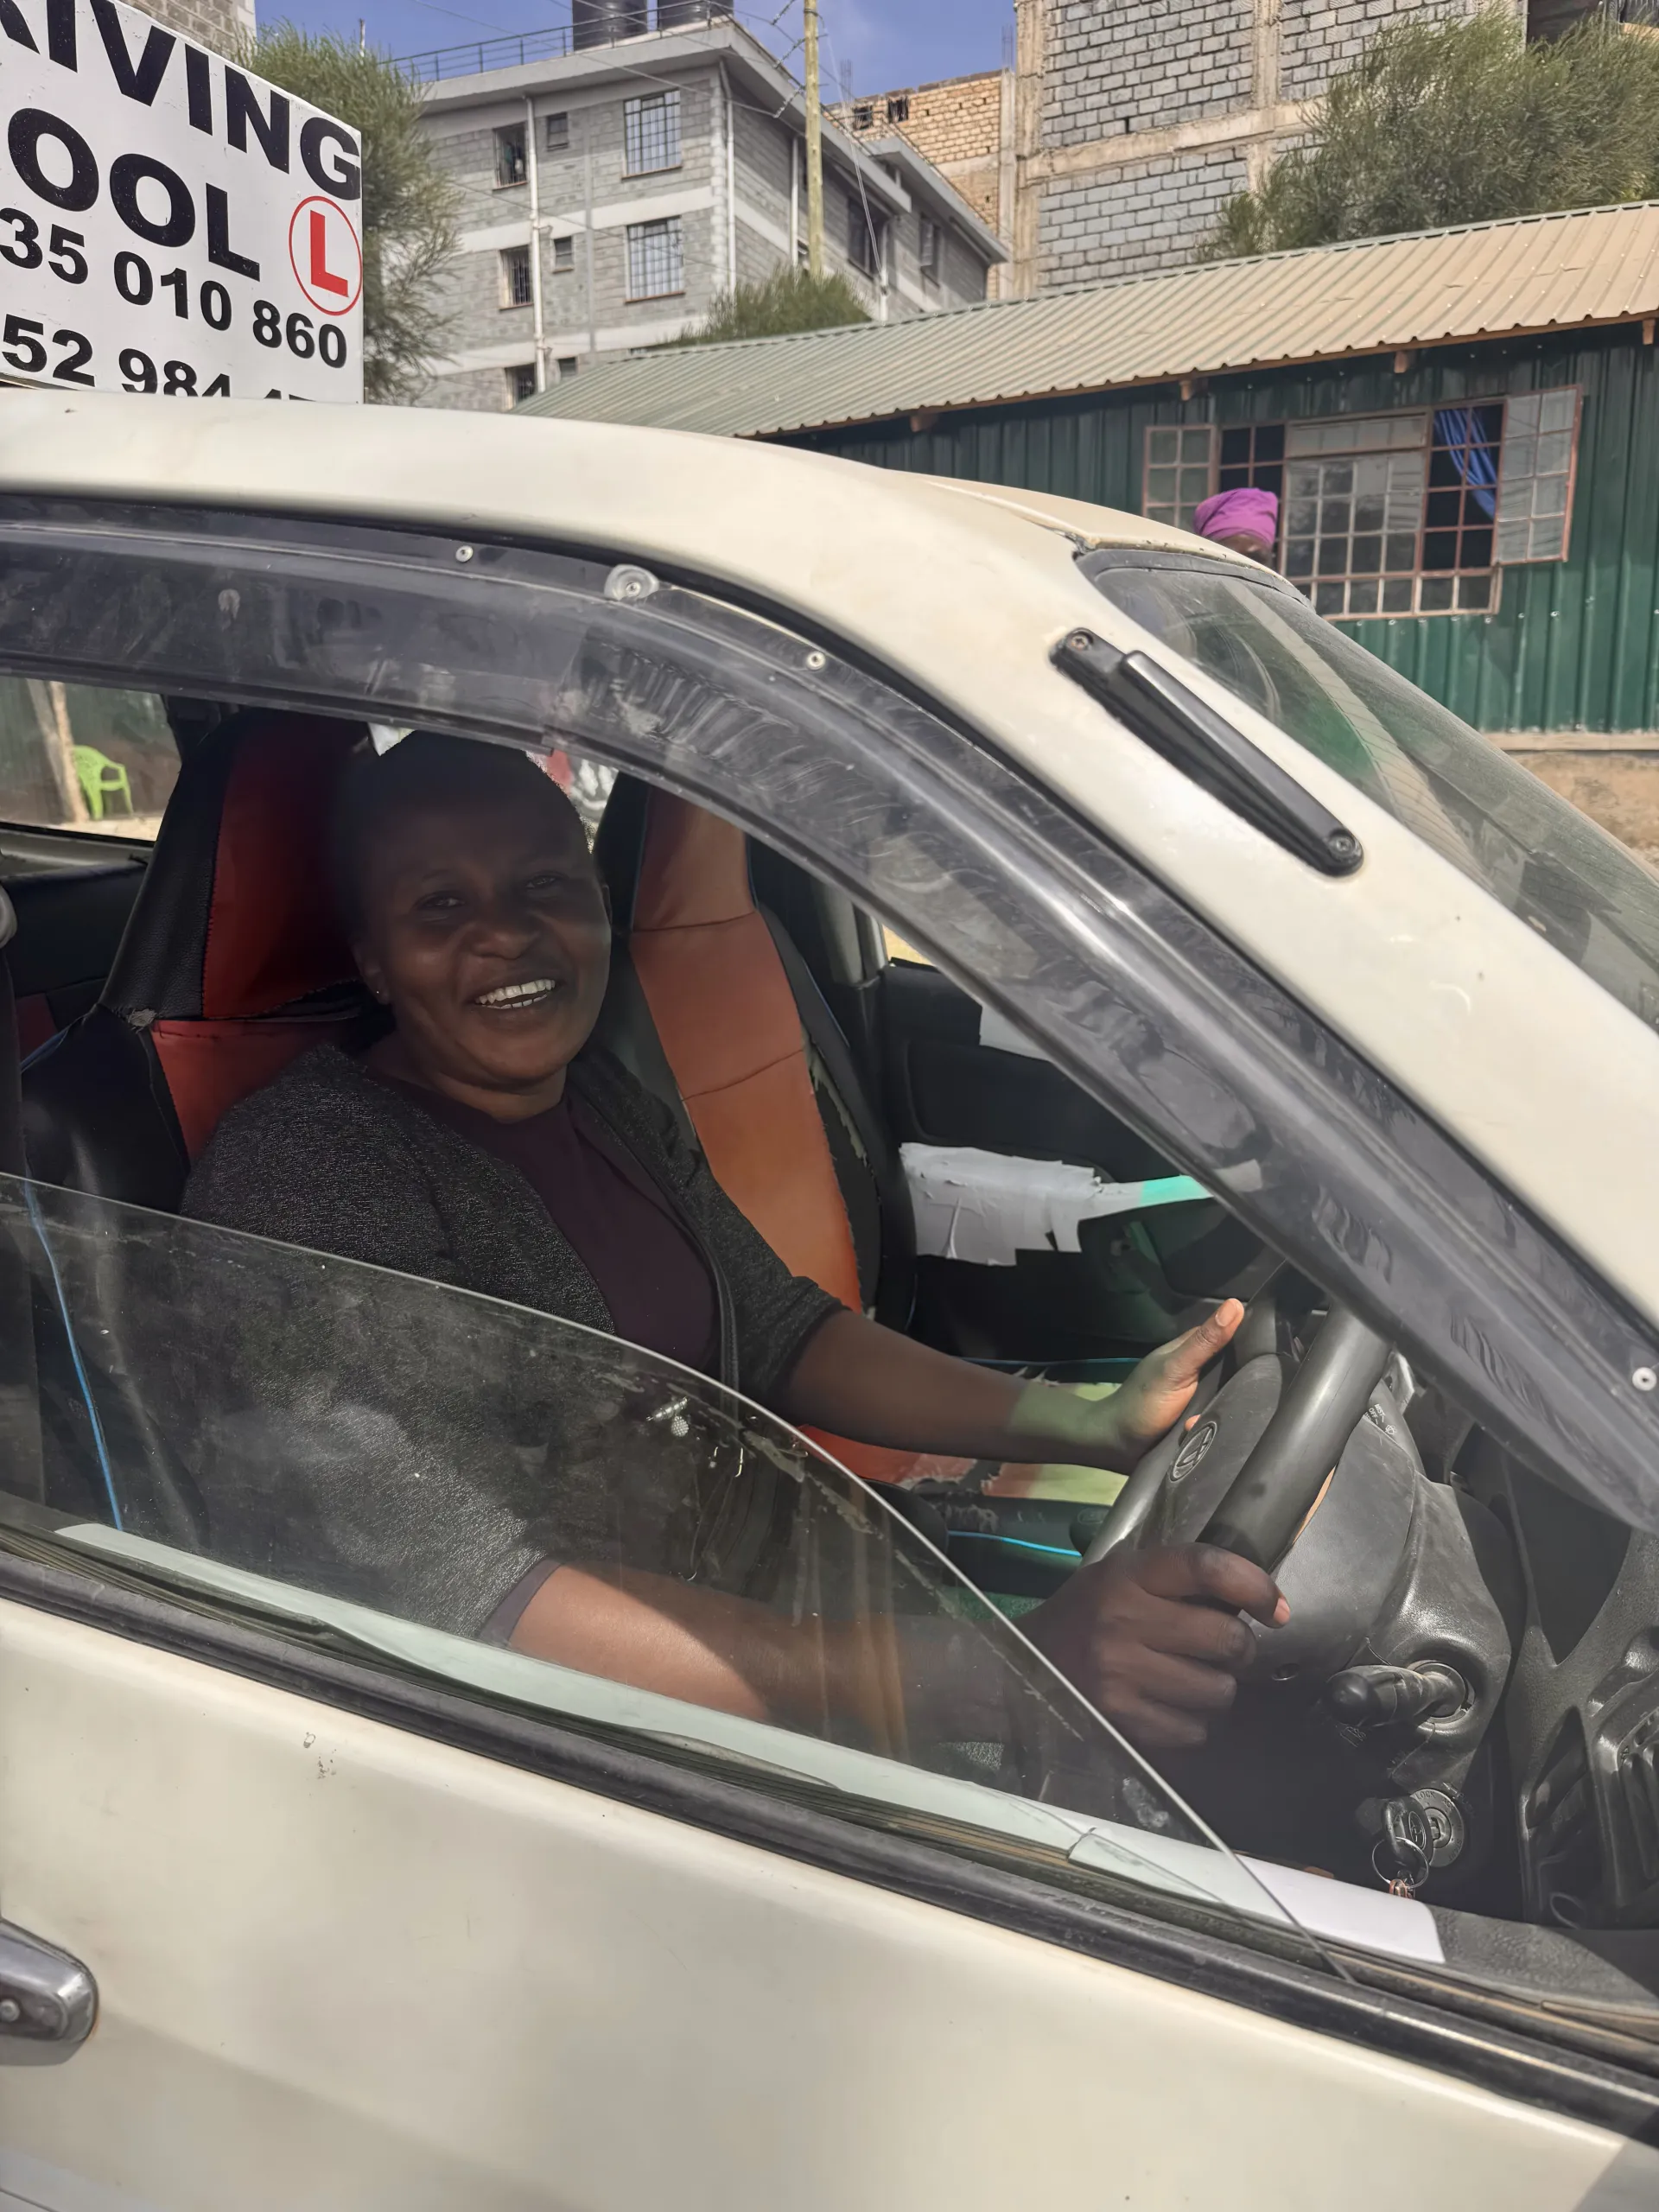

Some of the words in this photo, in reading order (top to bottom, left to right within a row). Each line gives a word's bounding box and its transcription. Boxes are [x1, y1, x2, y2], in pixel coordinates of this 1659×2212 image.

[0, 0, 361, 200] IVING
[8, 108, 260, 282] OOL
[0, 208, 88, 284] 35
[114, 251, 232, 331] 010
[252, 300, 347, 369] 860
[309, 210, 349, 298] L
[2, 315, 96, 387] 52
[1369, 1408, 1378, 1418] OFF
[1415, 1790, 1435, 1800] LOCK
